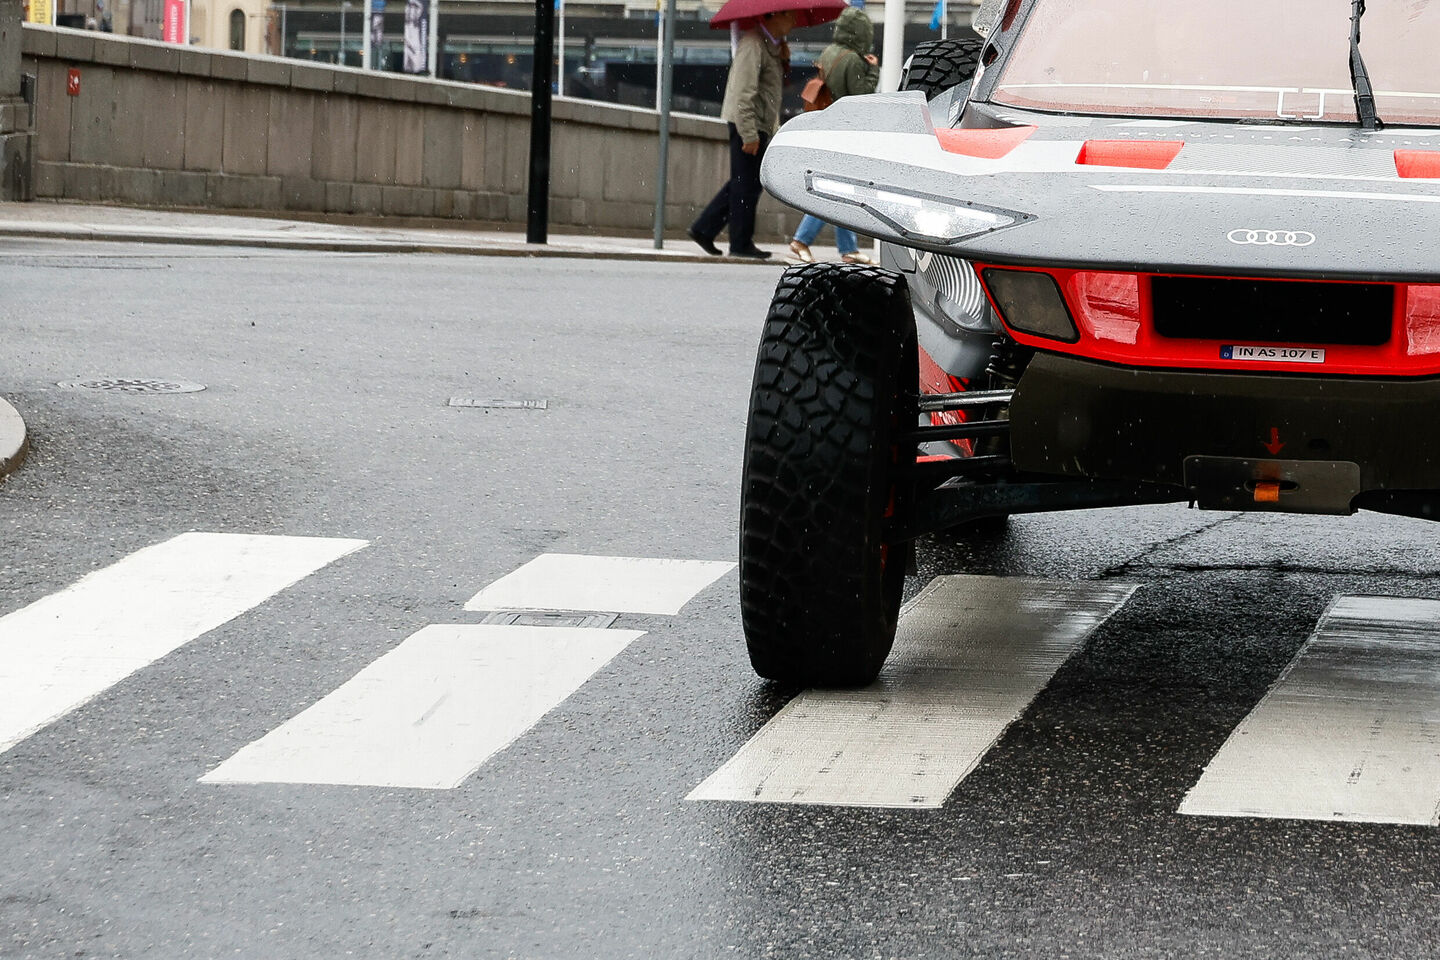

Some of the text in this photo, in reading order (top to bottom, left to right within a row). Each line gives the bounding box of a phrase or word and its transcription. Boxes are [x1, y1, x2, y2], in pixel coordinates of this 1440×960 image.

[1239, 347, 1319, 359] IN AS 107 E
